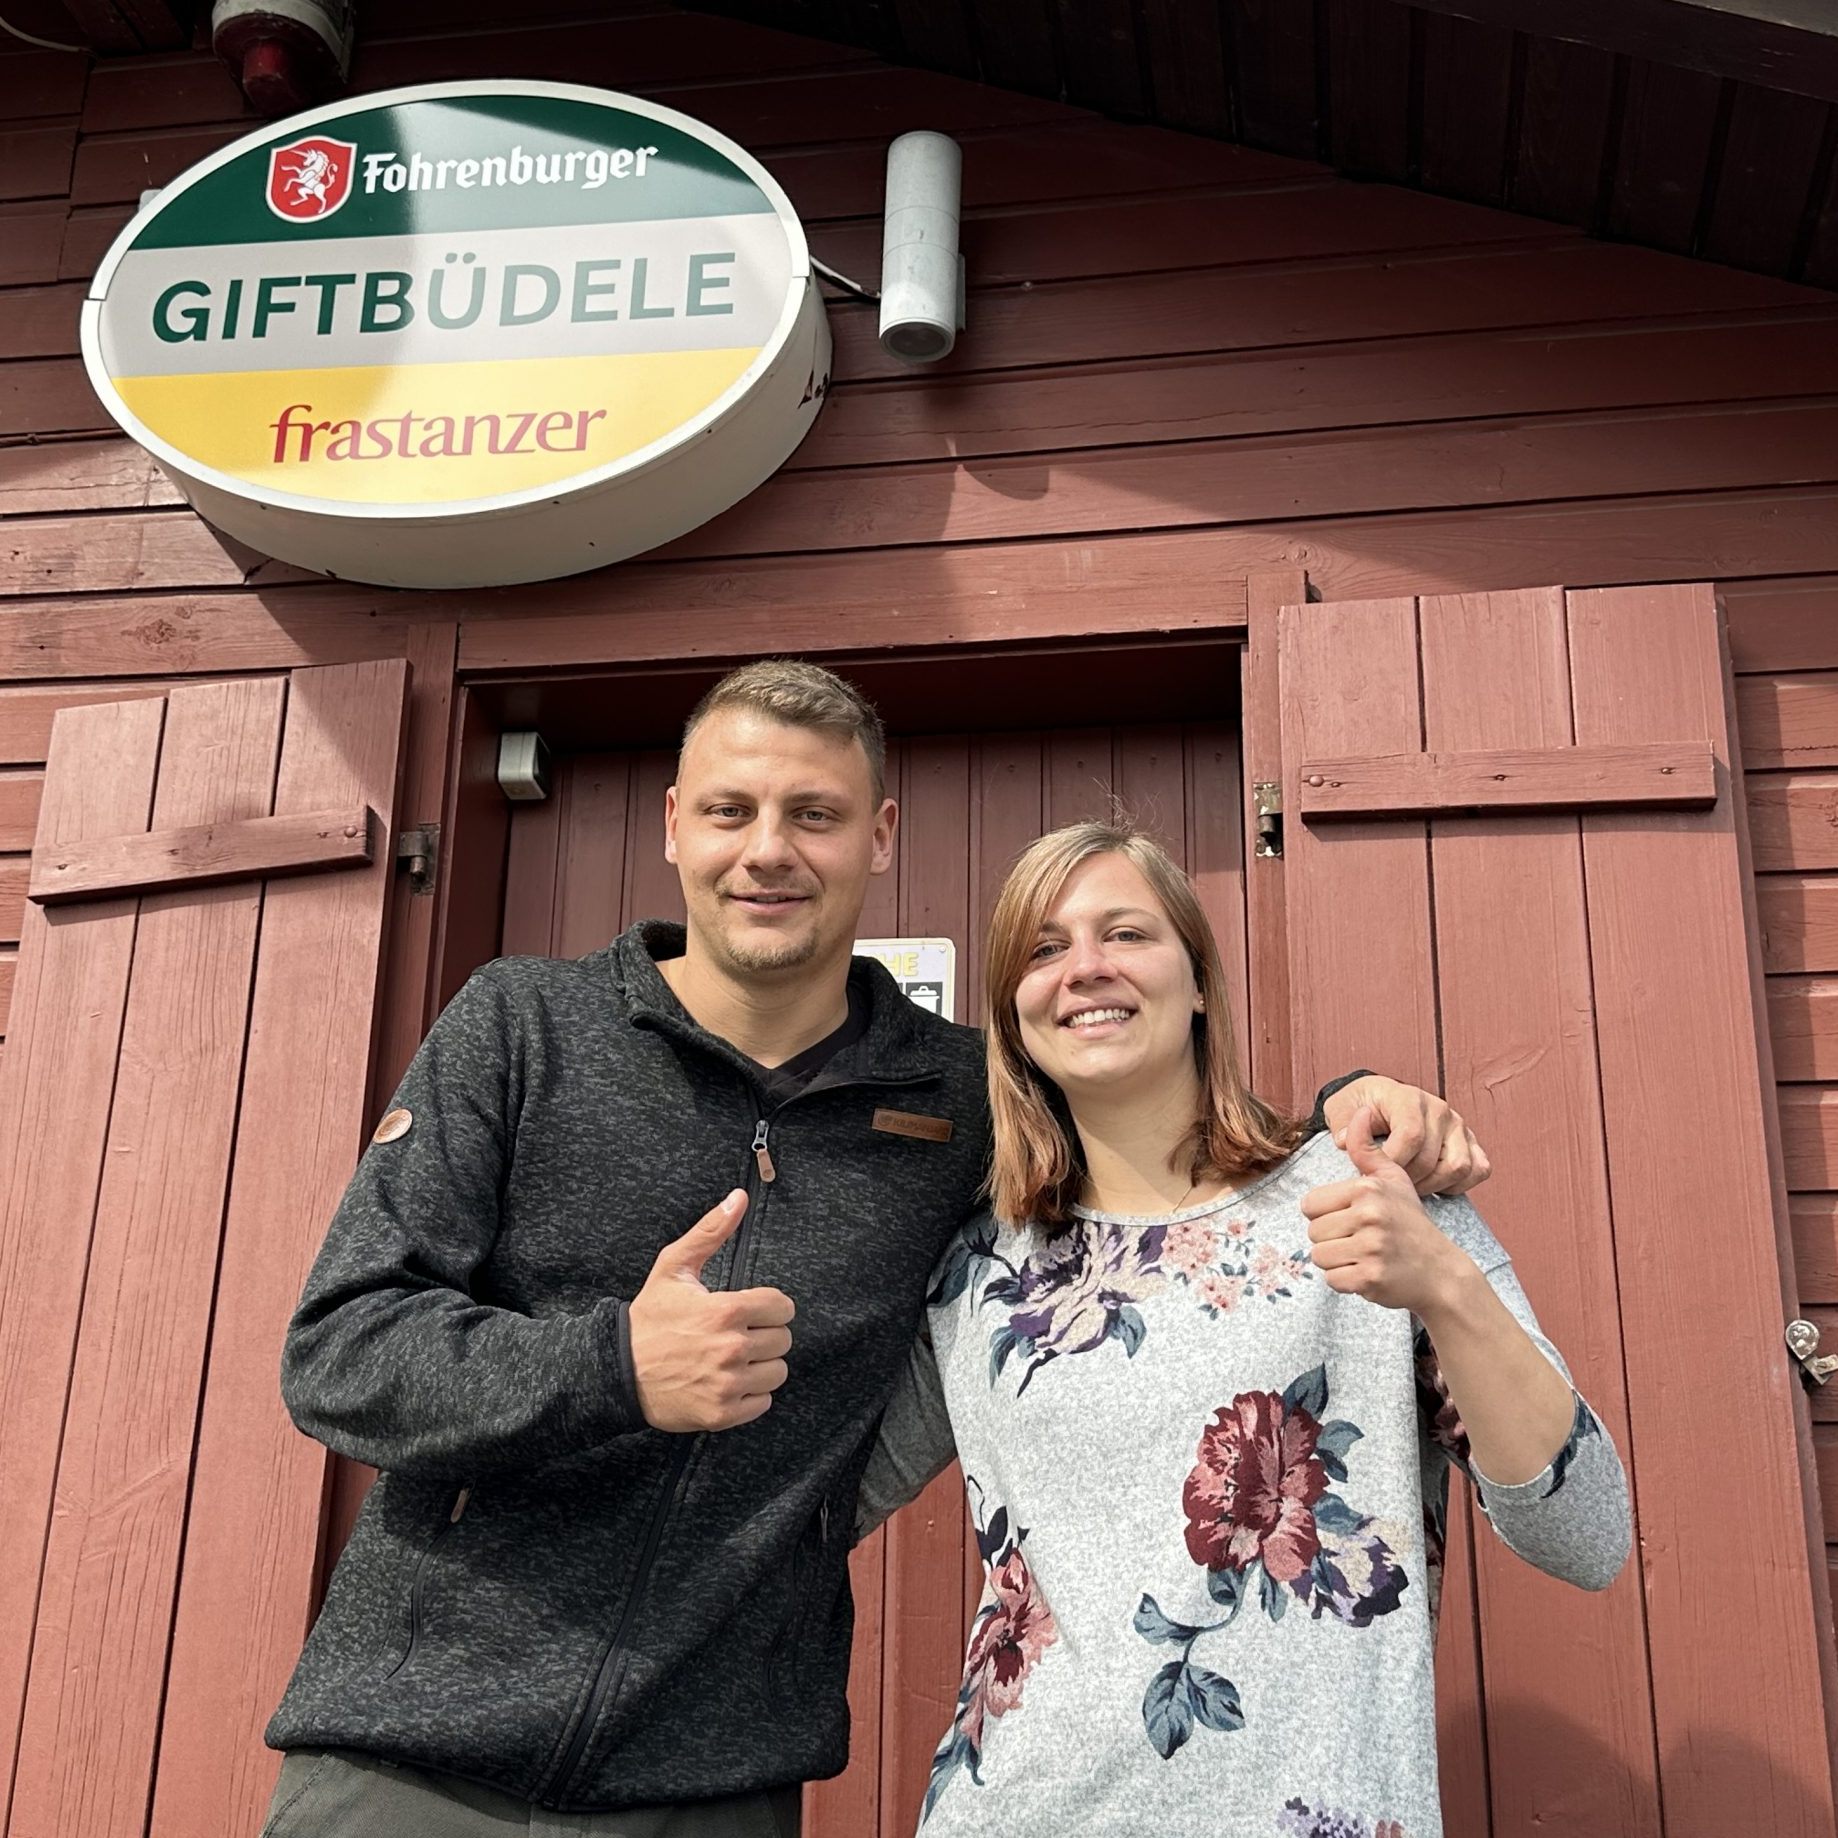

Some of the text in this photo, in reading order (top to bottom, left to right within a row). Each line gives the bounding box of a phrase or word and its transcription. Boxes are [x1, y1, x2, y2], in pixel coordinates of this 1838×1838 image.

[363, 145, 658, 194] Fohrenburger
[152, 252, 736, 343] GIFTBÜDELE
[269, 404, 606, 463] frastanzer
[876, 952, 919, 977] HE
